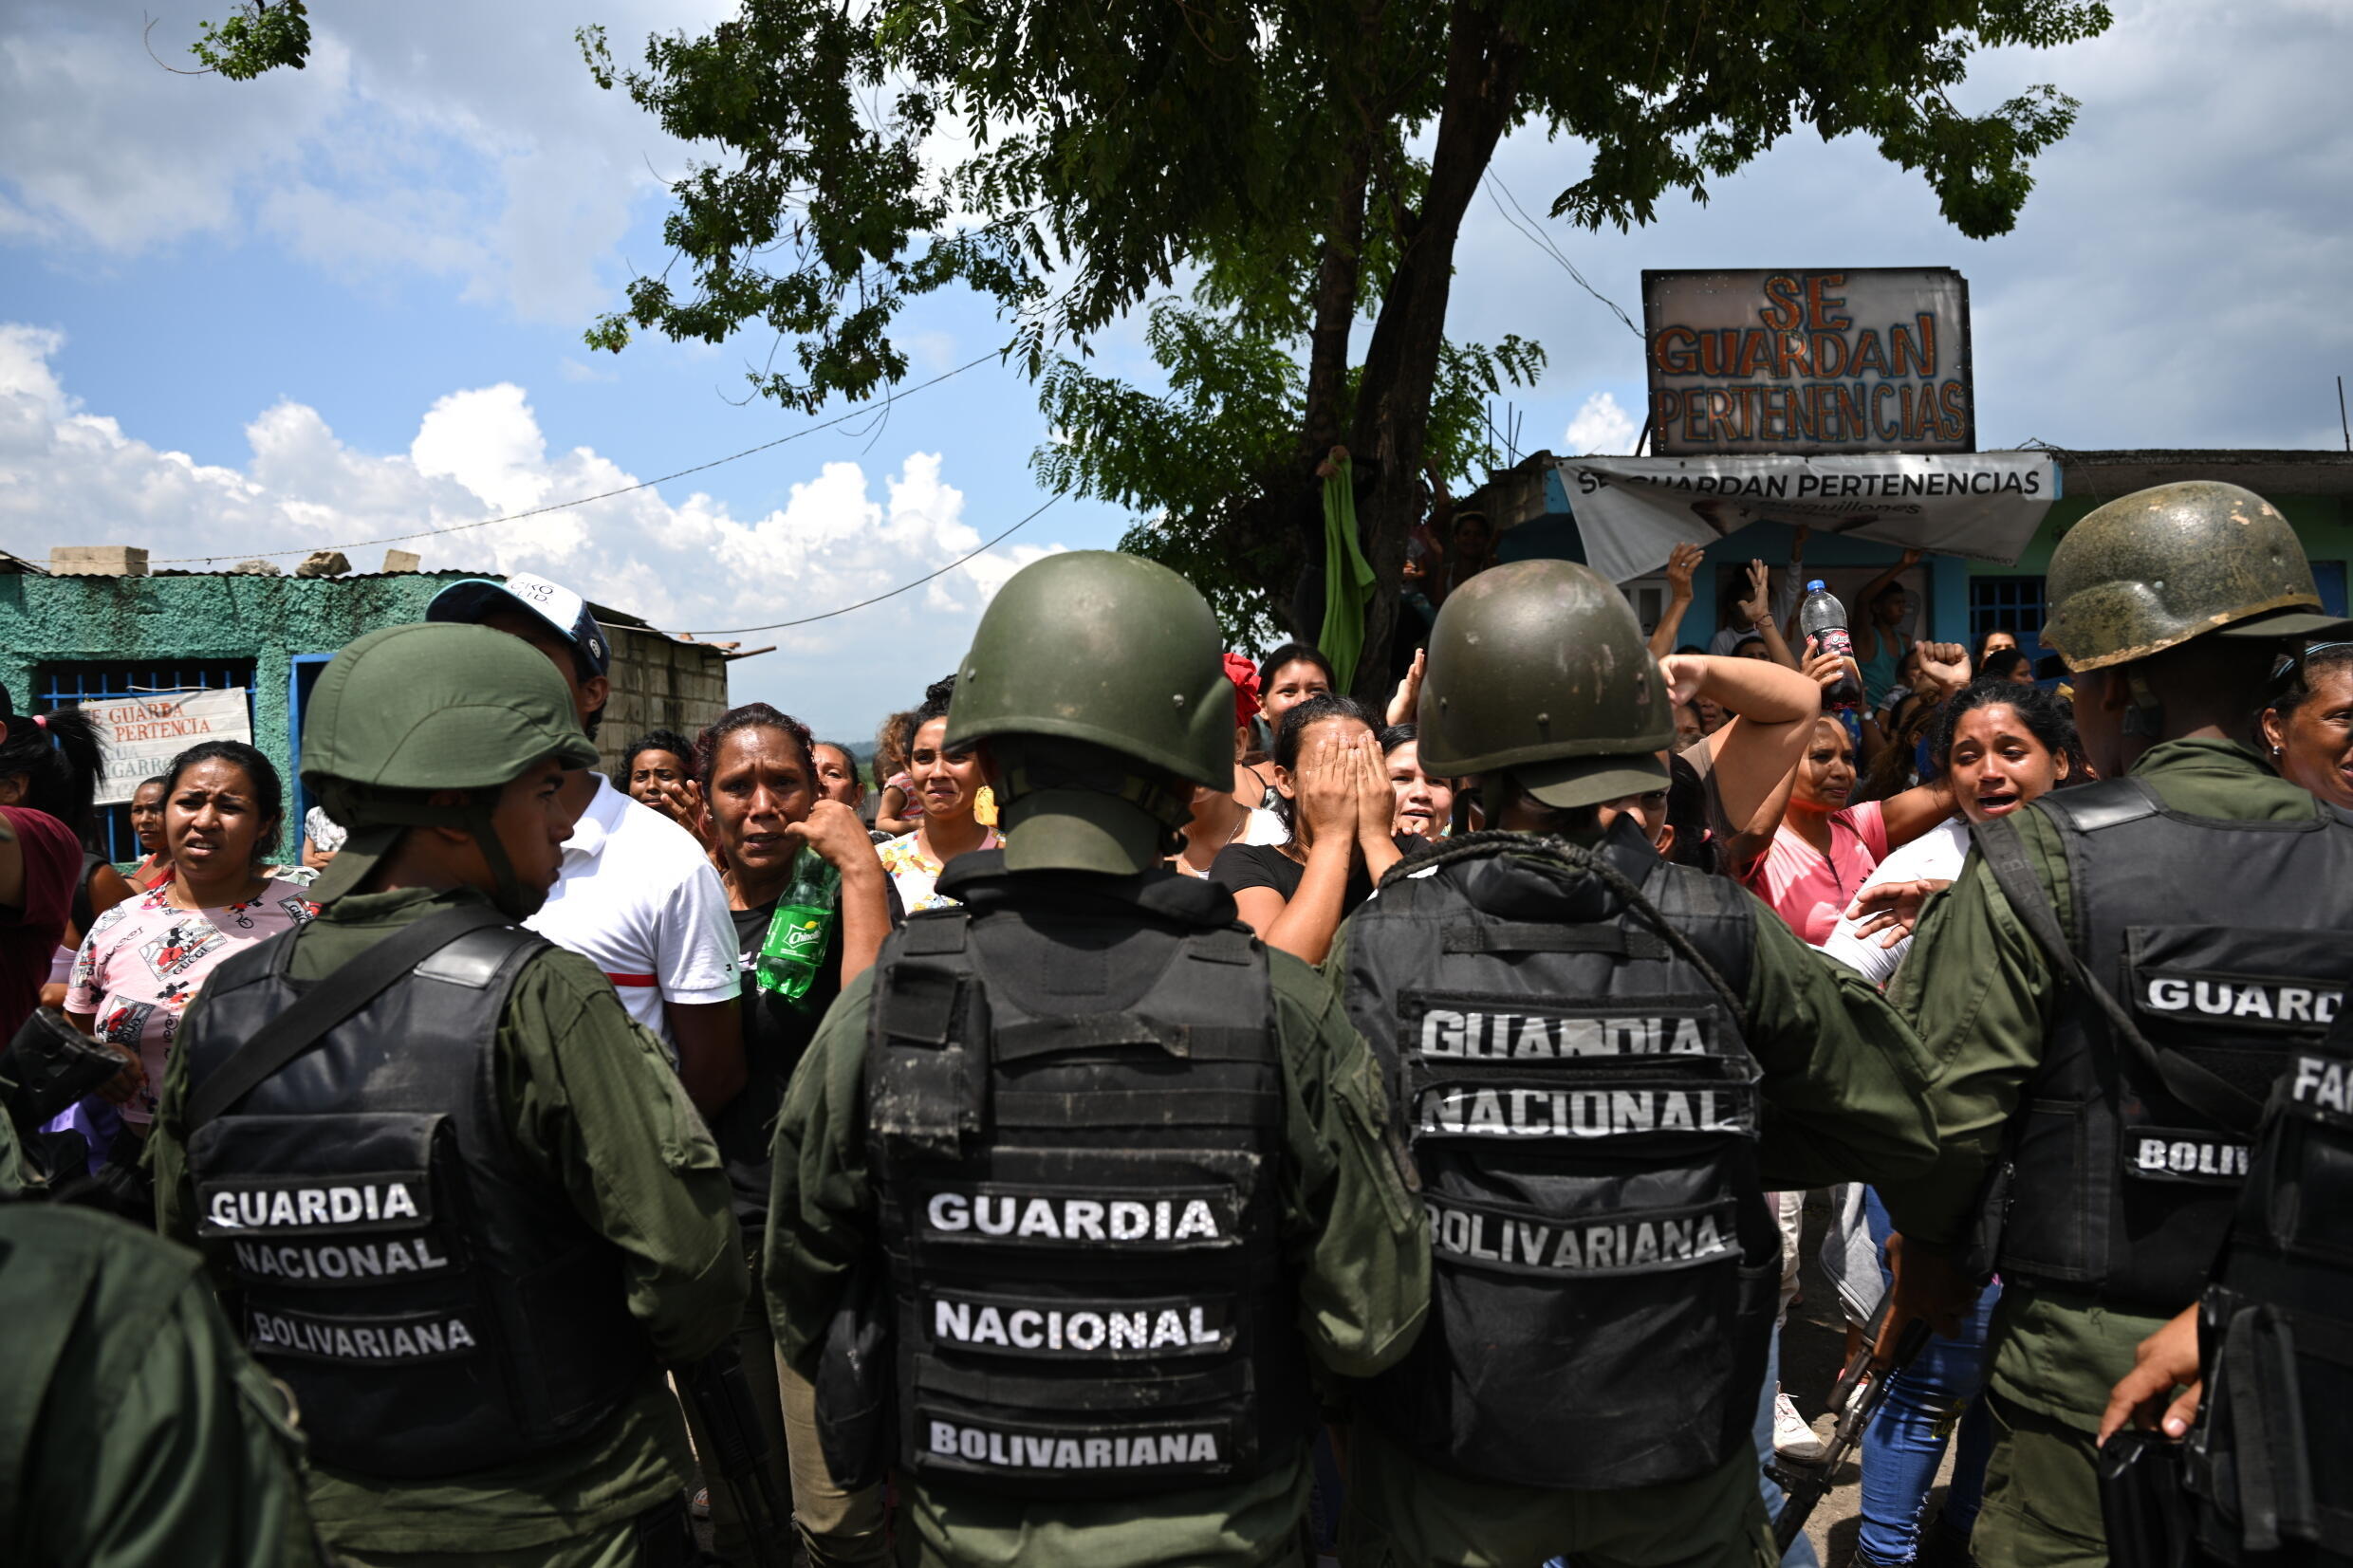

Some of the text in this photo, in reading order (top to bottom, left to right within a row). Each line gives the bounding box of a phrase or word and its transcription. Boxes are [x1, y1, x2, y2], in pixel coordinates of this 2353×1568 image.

[1759, 273, 1851, 332] SE
[1654, 312, 1938, 378] GUARDAN
[1655, 380, 1967, 443] PERTENENCIAS
[1797, 471, 2040, 497] PERTENENCIAS
[109, 702, 185, 725] GUARDA
[115, 719, 212, 743] PERTENCIA
[173, 947, 209, 975] GUCCI
[1421, 1009, 1707, 1059] GUARDIA
[2292, 1057, 2353, 1115] FA
[1420, 1087, 1742, 1137] NACIONAL
[211, 1183, 418, 1227] GUARDIA
[927, 1192, 1219, 1241] GUARDIA
[234, 1237, 448, 1279] NACIONAL
[253, 1312, 475, 1357] BOLIVARIANA
[935, 1300, 1221, 1350] NACIONAL
[930, 1420, 1218, 1468] BOLIVARIANA
